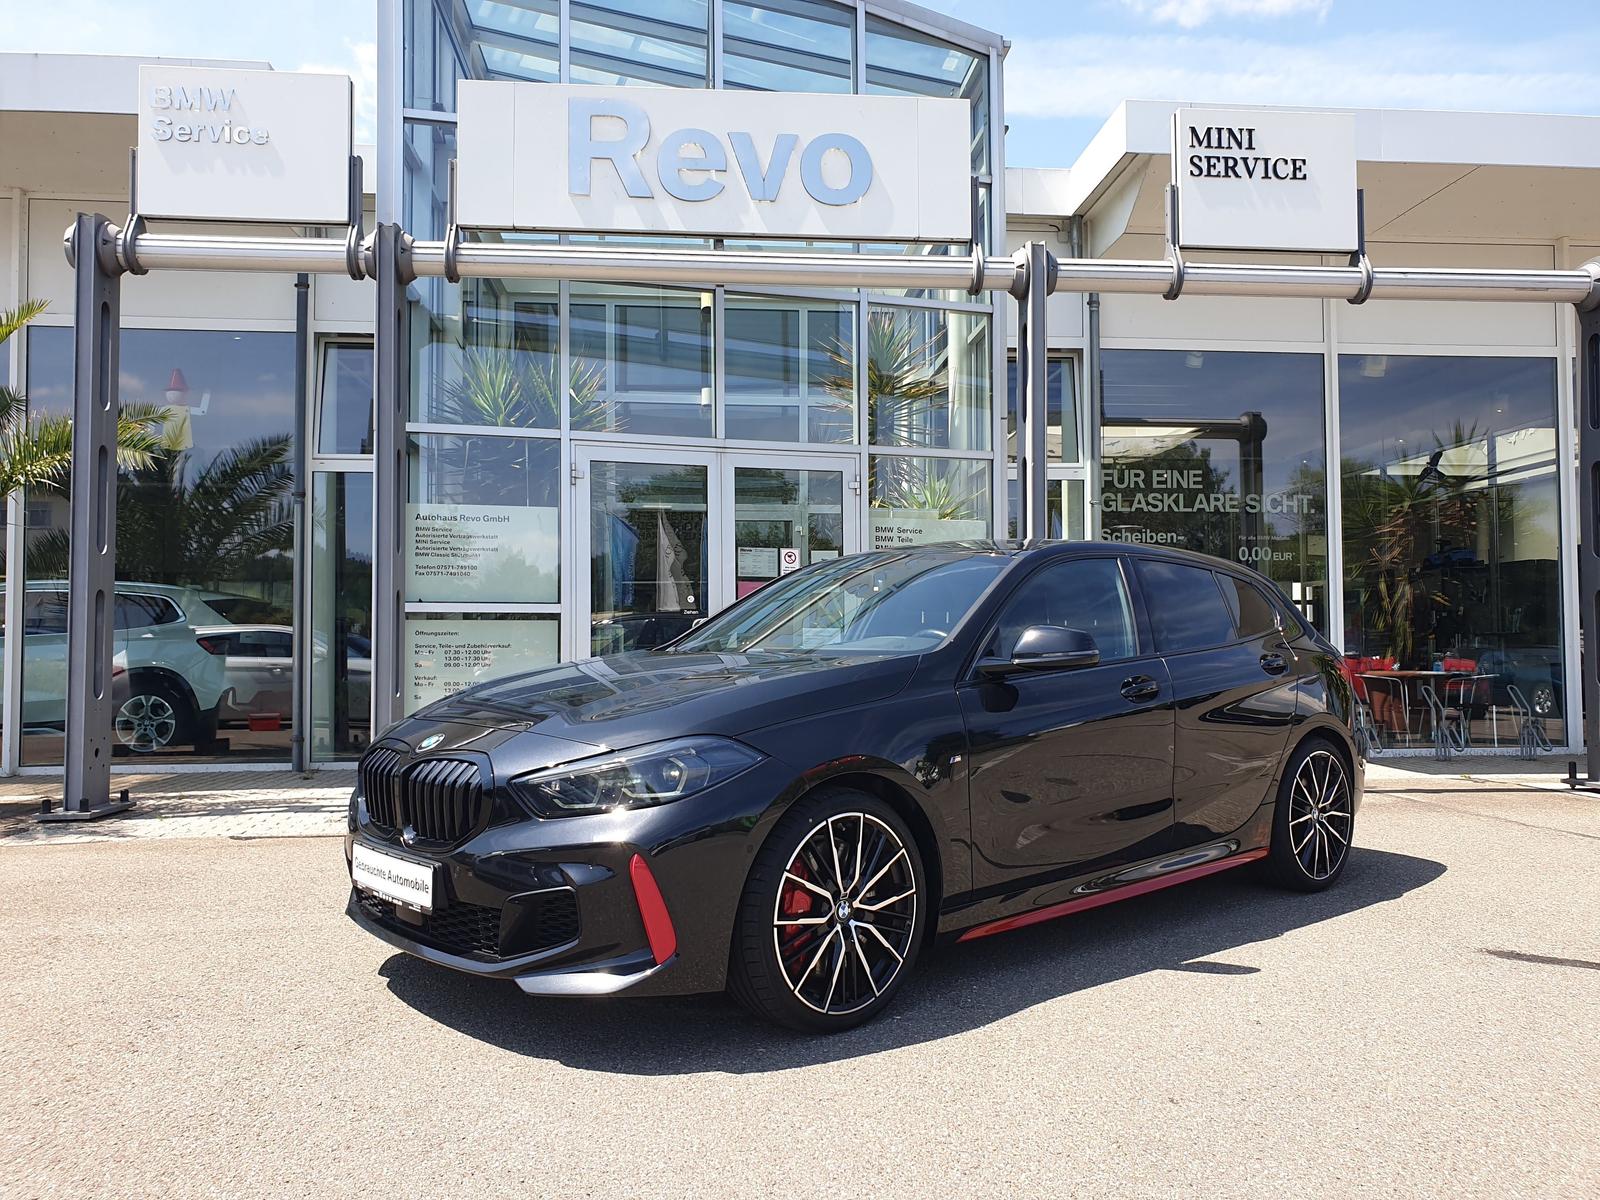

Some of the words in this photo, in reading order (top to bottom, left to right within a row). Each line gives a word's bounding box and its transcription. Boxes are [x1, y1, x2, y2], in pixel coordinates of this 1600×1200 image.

[151, 85, 235, 112] BMW
[152, 116, 270, 145] Service
[1188, 126, 1256, 150] MINI
[568, 97, 874, 206] Revo
[1189, 155, 1307, 181] SERVICE
[1101, 465, 1145, 489] FÜR
[1152, 469, 1203, 489] EINE
[1101, 493, 1240, 513] GLASKLARE
[1245, 493, 1316, 514] SICHT.
[415, 513, 458, 522] Autohaus
[459, 514, 481, 522] Revo
[482, 514, 510, 523] GmbH
[897, 526, 923, 534] Service
[1101, 528, 1185, 543] Scheiben-
[1238, 546, 1272, 564] 0,00
[354, 856, 386, 880] Gebrauchte
[387, 869, 429, 894] Automobile
